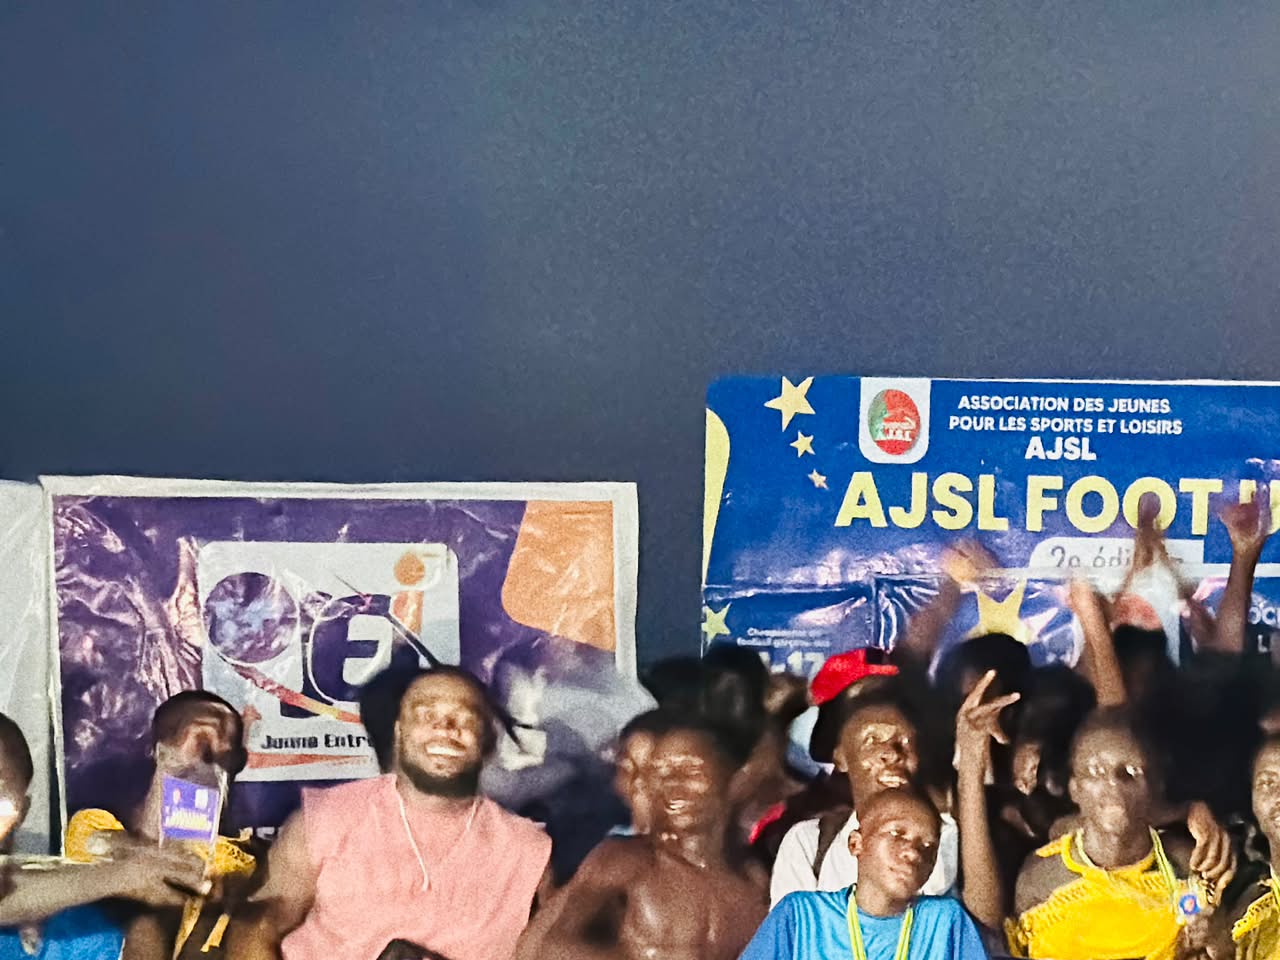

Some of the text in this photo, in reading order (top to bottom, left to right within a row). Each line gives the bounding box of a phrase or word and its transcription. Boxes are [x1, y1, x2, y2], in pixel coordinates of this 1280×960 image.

[957, 395, 1171, 414] ASSOCIATION DES JEUNES
[948, 417, 1183, 435] POUR LES SPORTS ET LOISIRS
[1024, 436, 1098, 461] AJSL
[835, 470, 1009, 532] AJSL
[1026, 474, 1224, 537] FOOT
